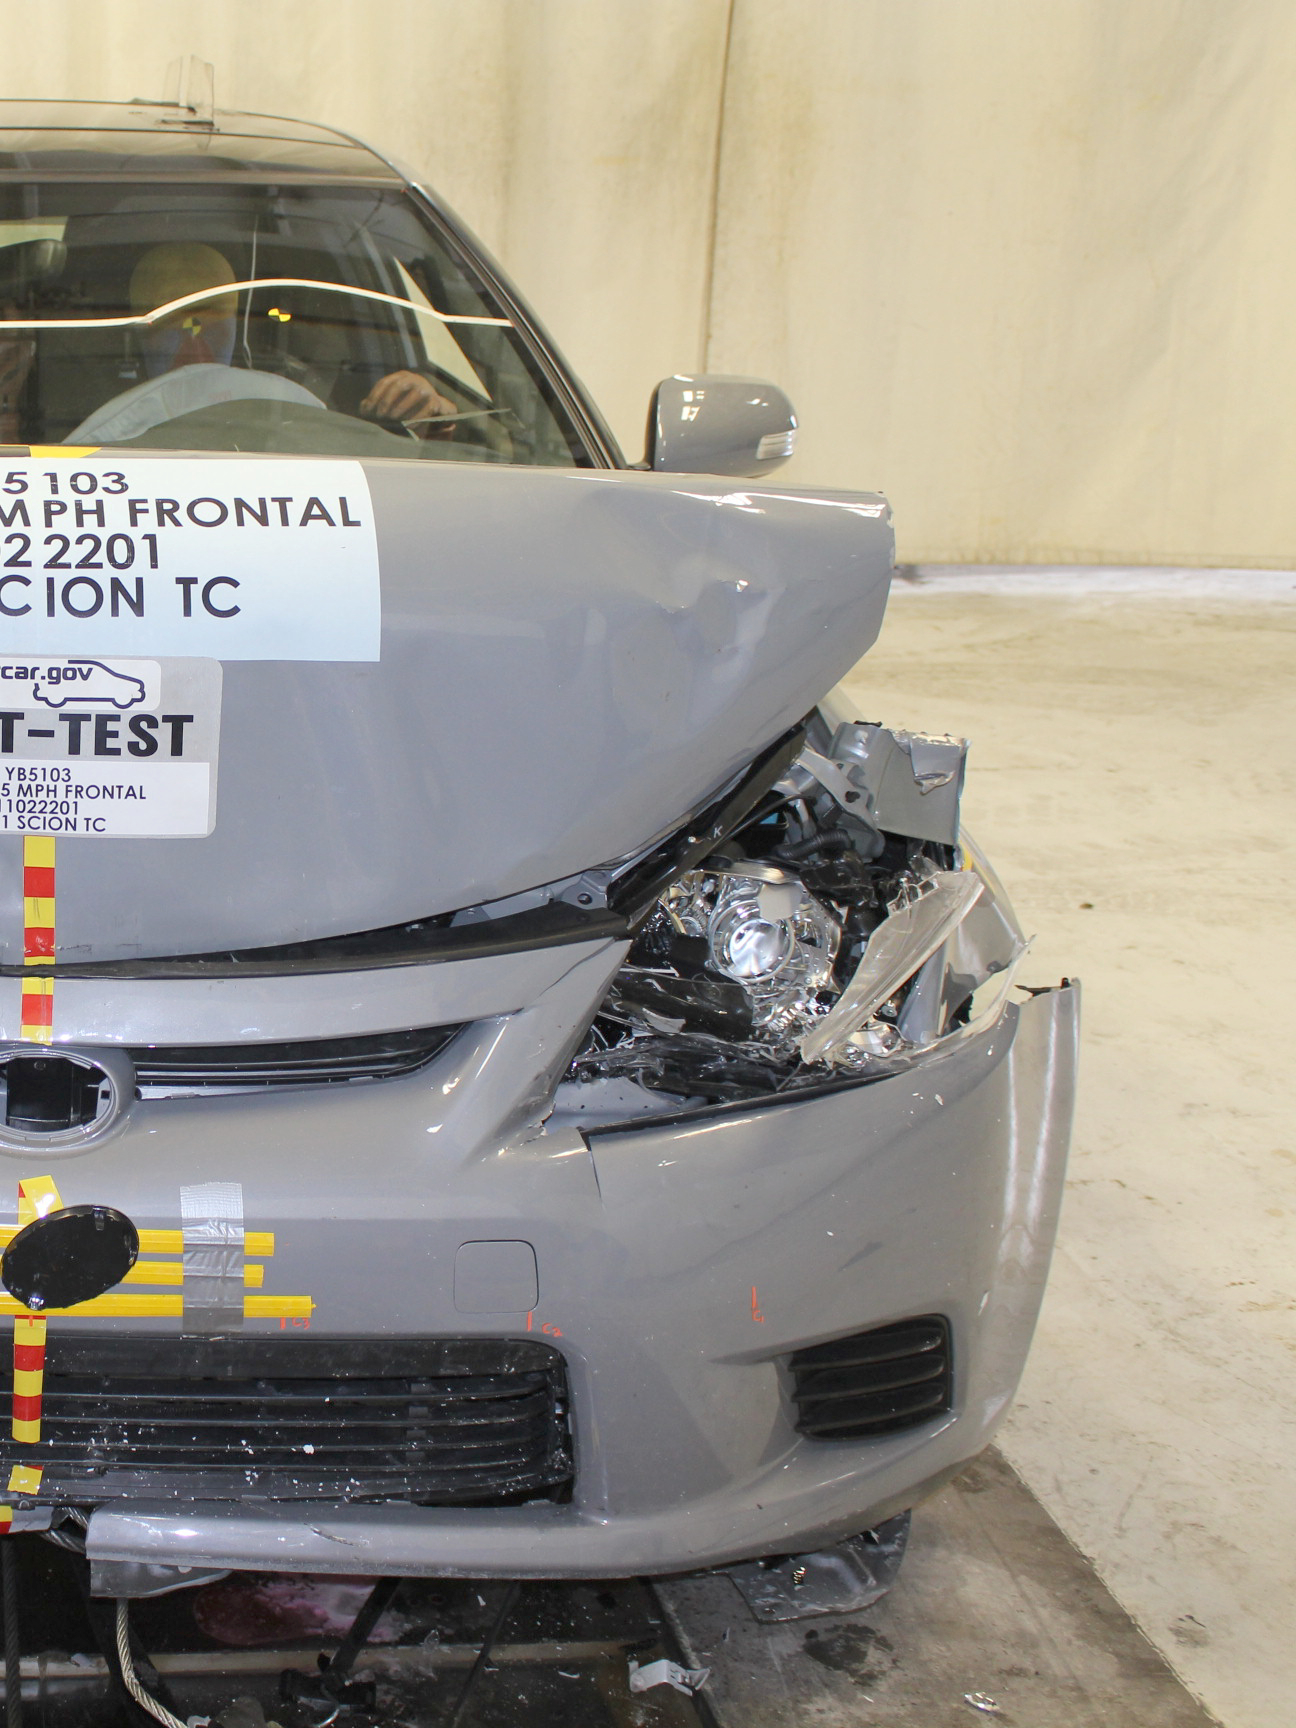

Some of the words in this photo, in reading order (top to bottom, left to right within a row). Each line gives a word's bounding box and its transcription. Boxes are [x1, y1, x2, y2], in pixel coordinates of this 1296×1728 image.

[129, 497, 360, 527] FRONTAL
[176, 577, 240, 618] TC
[6, 767, 71, 782] YB5103
[17, 784, 56, 798] MPH
[66, 785, 145, 799] FRONTAL
[18, 815, 76, 831] SCION
[84, 818, 105, 832] TC
